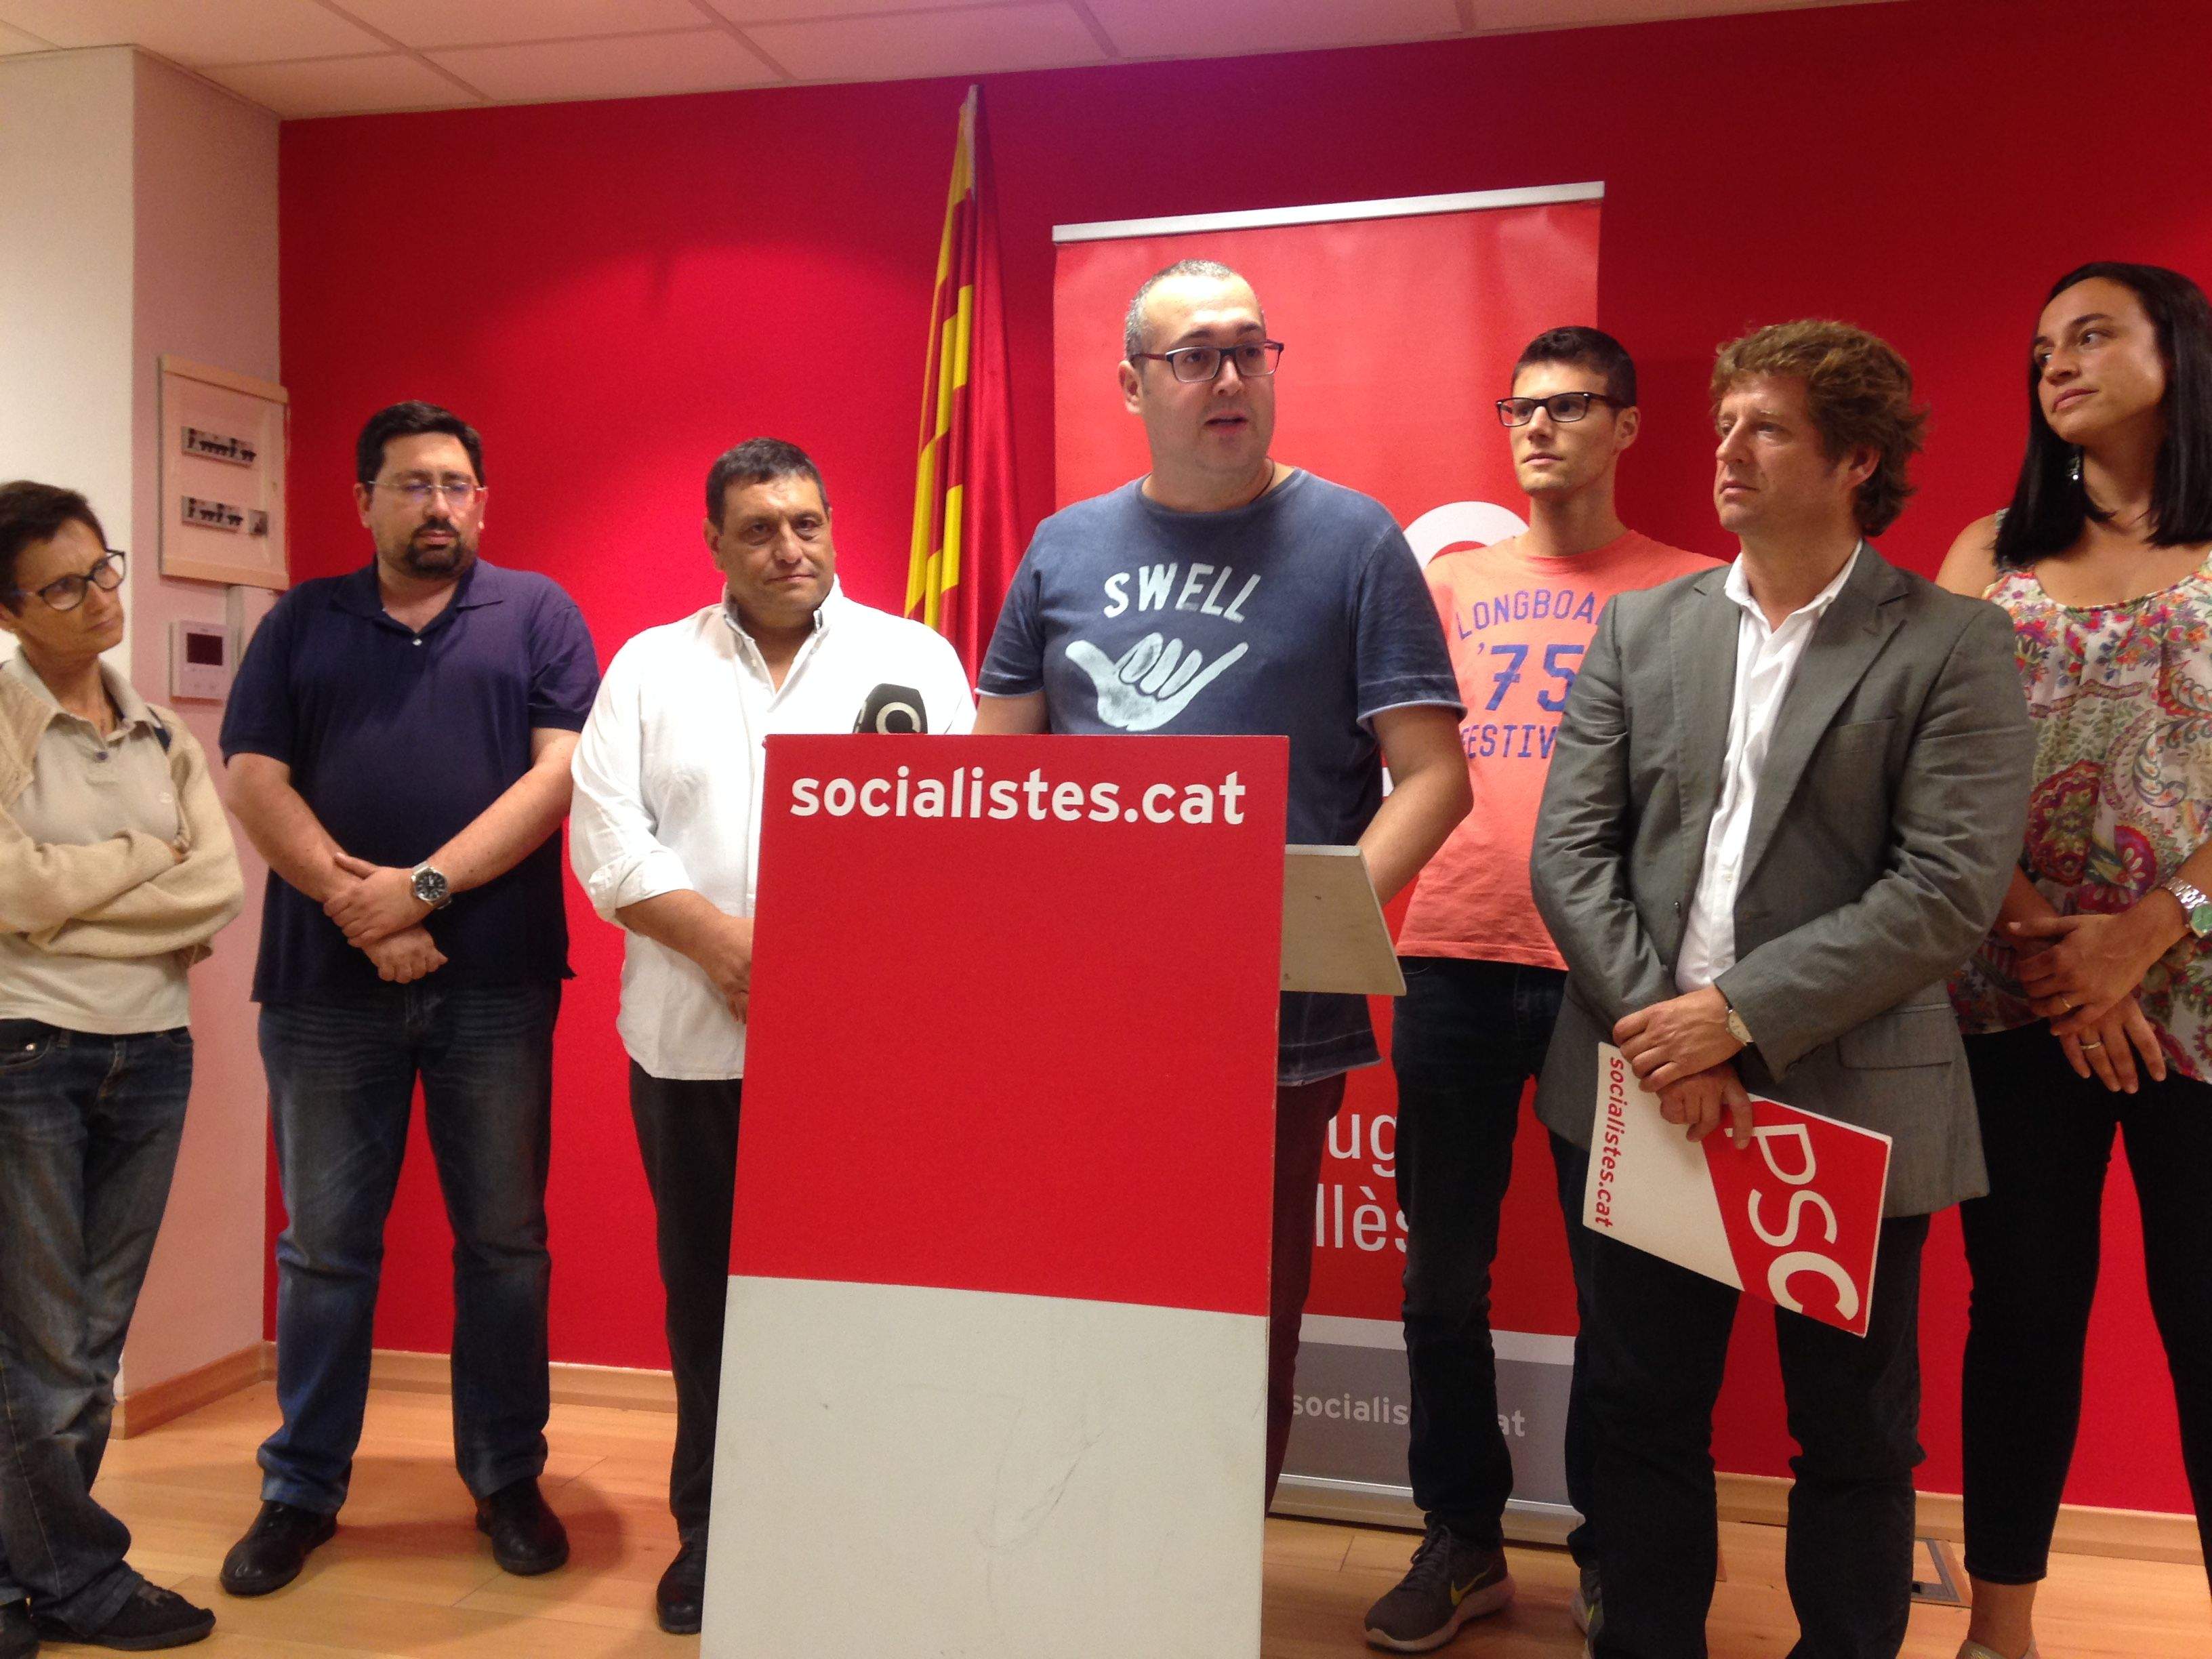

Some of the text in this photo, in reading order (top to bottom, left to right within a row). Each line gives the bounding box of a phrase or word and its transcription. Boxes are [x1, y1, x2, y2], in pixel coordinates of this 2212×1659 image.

[1103, 562, 1261, 623] SWELL
[1456, 589, 1601, 639] LONGBOA
[790, 765, 1246, 824] socialistes.cat
[1595, 1057, 1628, 1228] socialistes.cat
[1724, 1123, 1860, 1321] PSC
